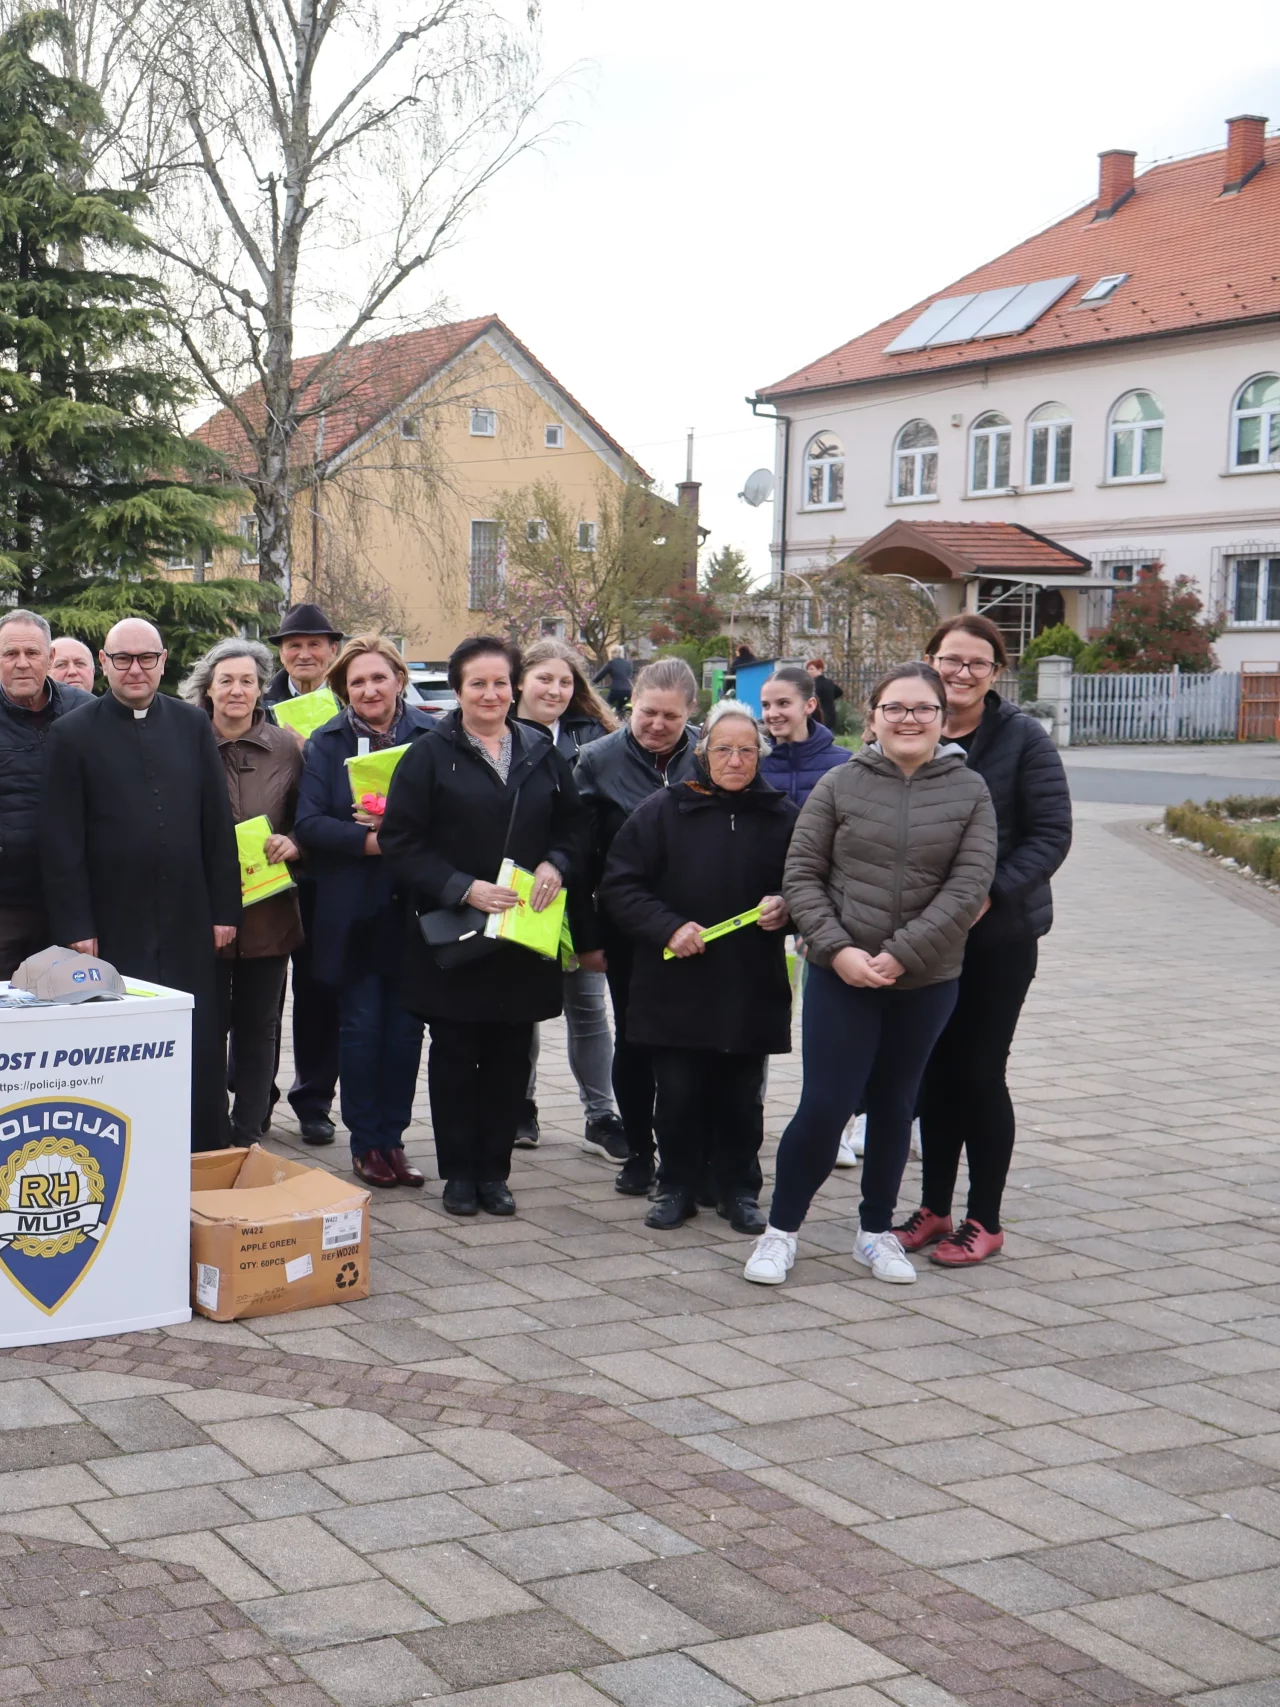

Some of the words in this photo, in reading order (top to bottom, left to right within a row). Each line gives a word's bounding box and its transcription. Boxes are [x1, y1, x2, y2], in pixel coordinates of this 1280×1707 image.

[39, 1051, 49, 1068] I
[53, 1040, 176, 1068] POVJERENJE
[19, 1171, 80, 1209] RH
[17, 1210, 81, 1232] MUP
[241, 1226, 264, 1236] W422
[240, 1242, 267, 1253] APPLE
[269, 1238, 297, 1249] GREEN
[239, 1261, 259, 1270] QTY:
[261, 1257, 286, 1268] 60PCS
